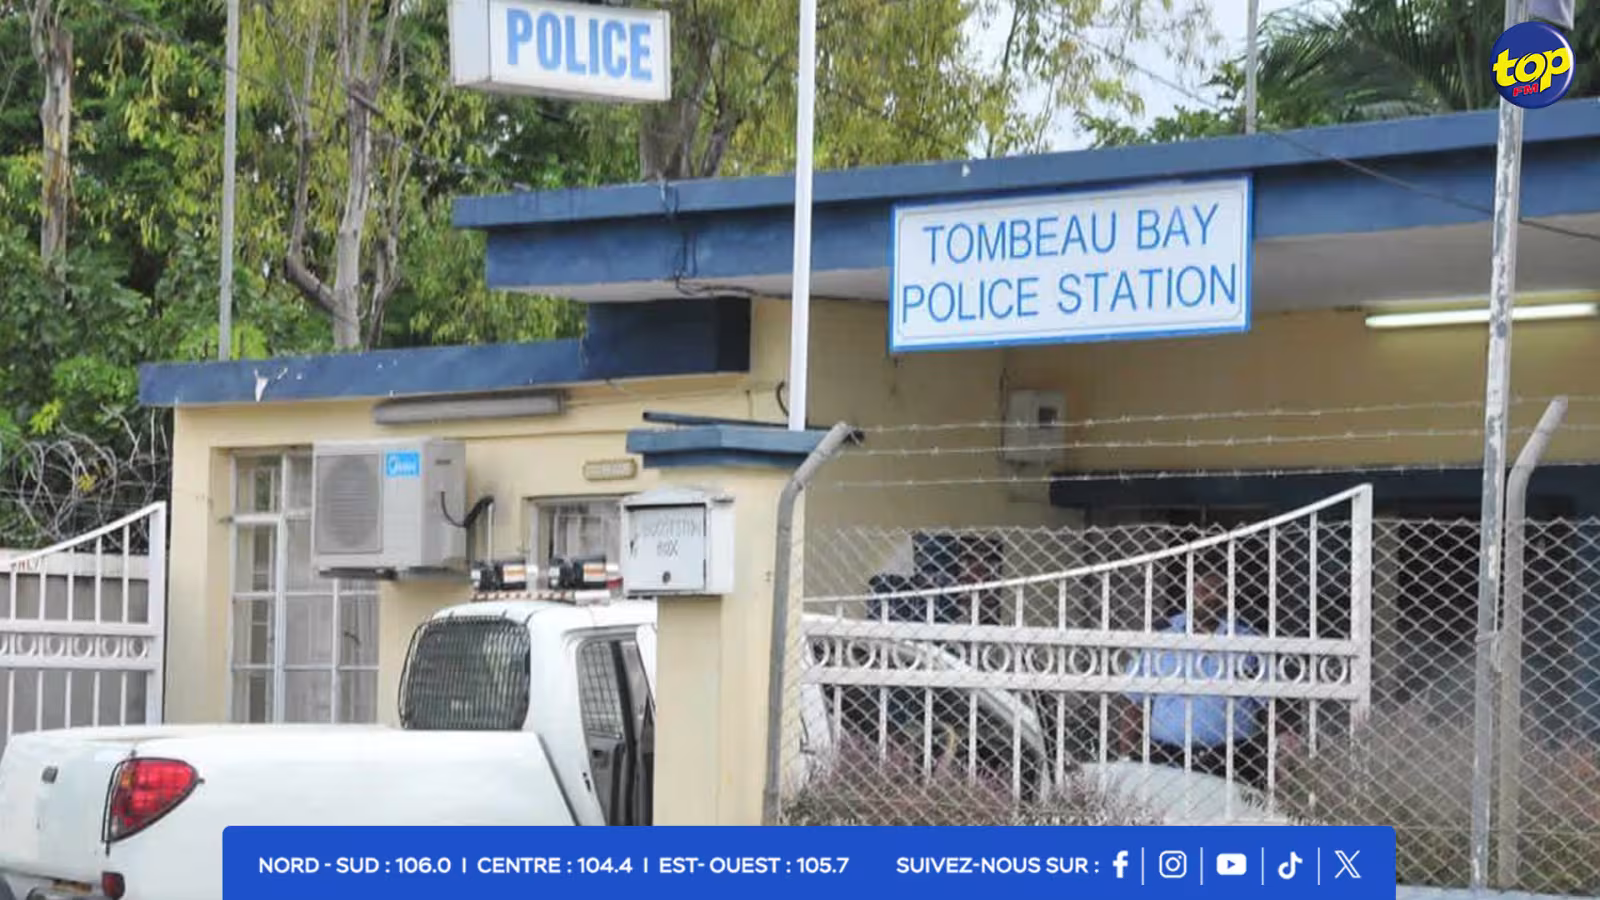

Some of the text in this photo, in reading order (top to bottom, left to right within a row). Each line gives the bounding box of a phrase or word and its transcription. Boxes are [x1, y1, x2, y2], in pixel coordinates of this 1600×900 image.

[506, 8, 653, 81] POLICE
[922, 203, 1219, 265] TOMBEAU BAY
[902, 263, 1237, 324] POLICE STATION
